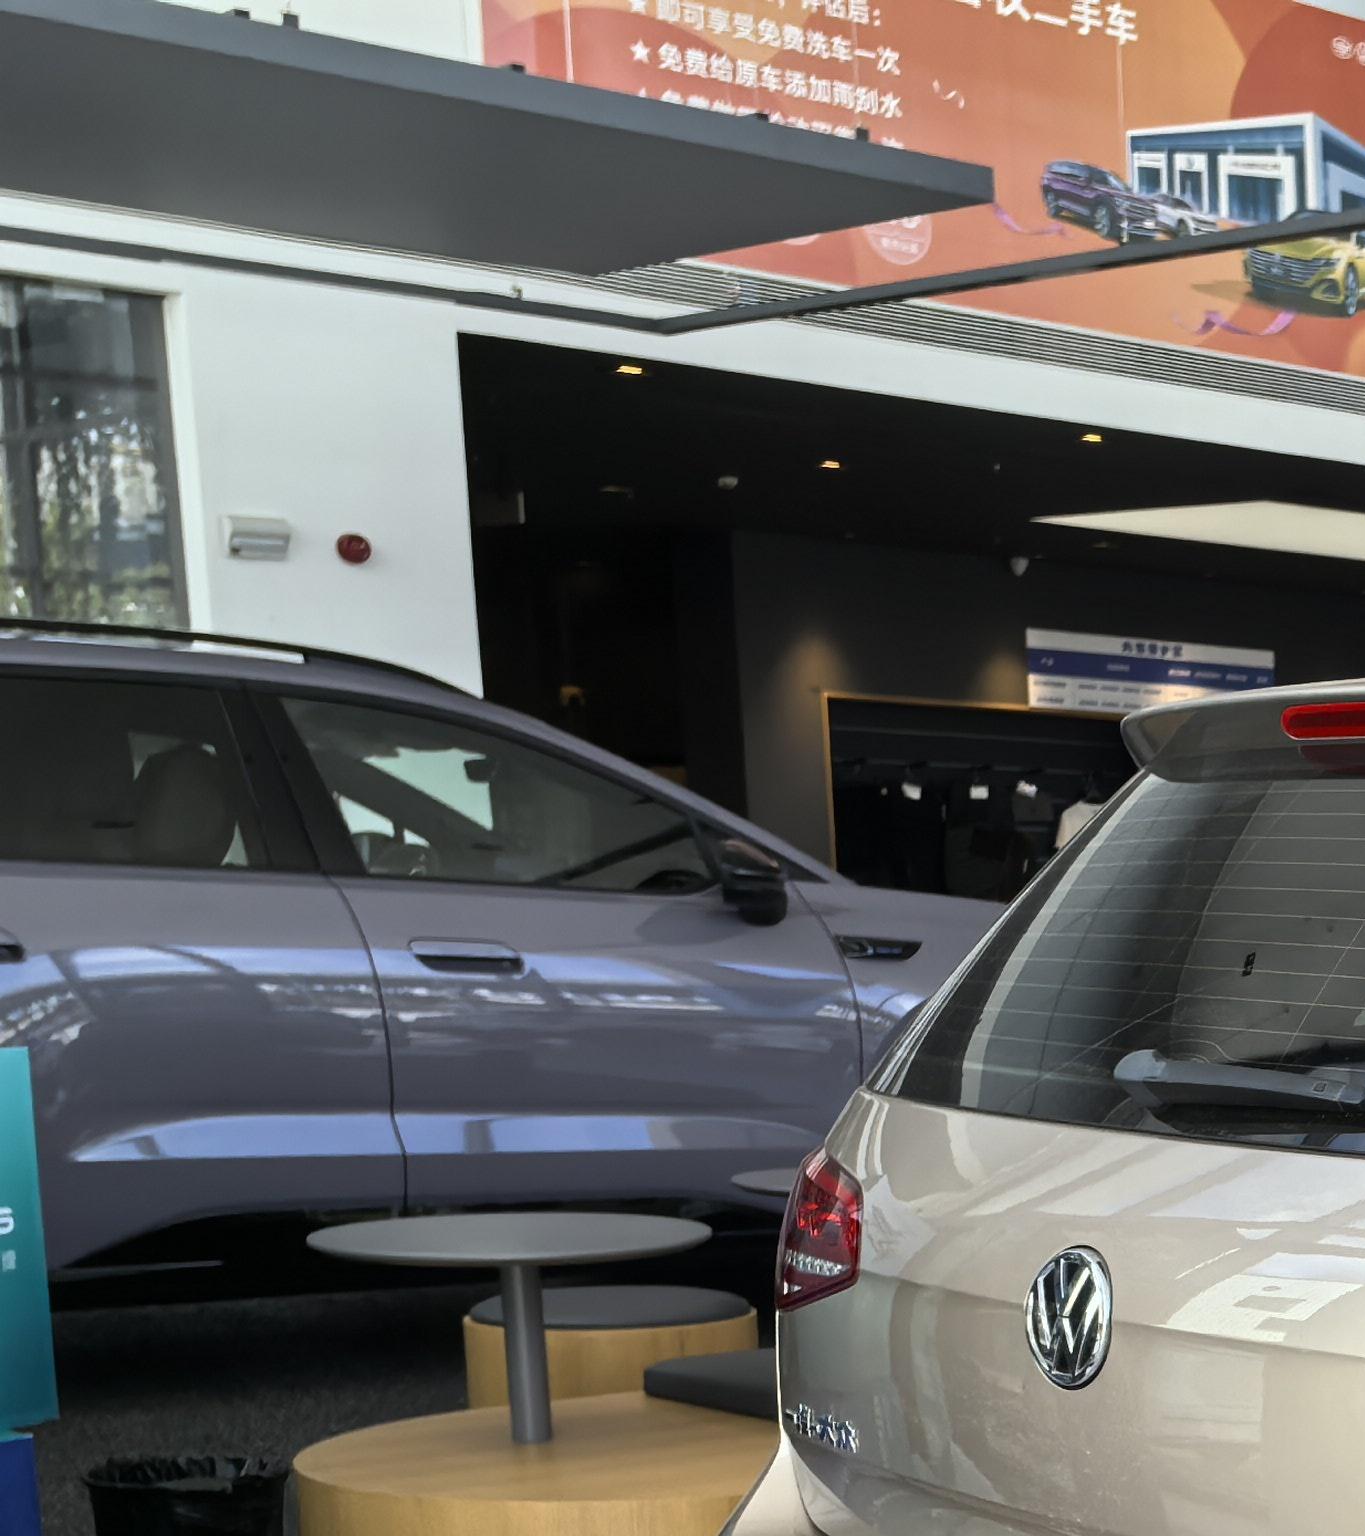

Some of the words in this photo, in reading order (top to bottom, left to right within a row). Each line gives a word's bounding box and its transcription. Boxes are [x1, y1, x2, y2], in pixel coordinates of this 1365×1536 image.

[657, 41, 903, 119] 免费给原车添加雨刮水
